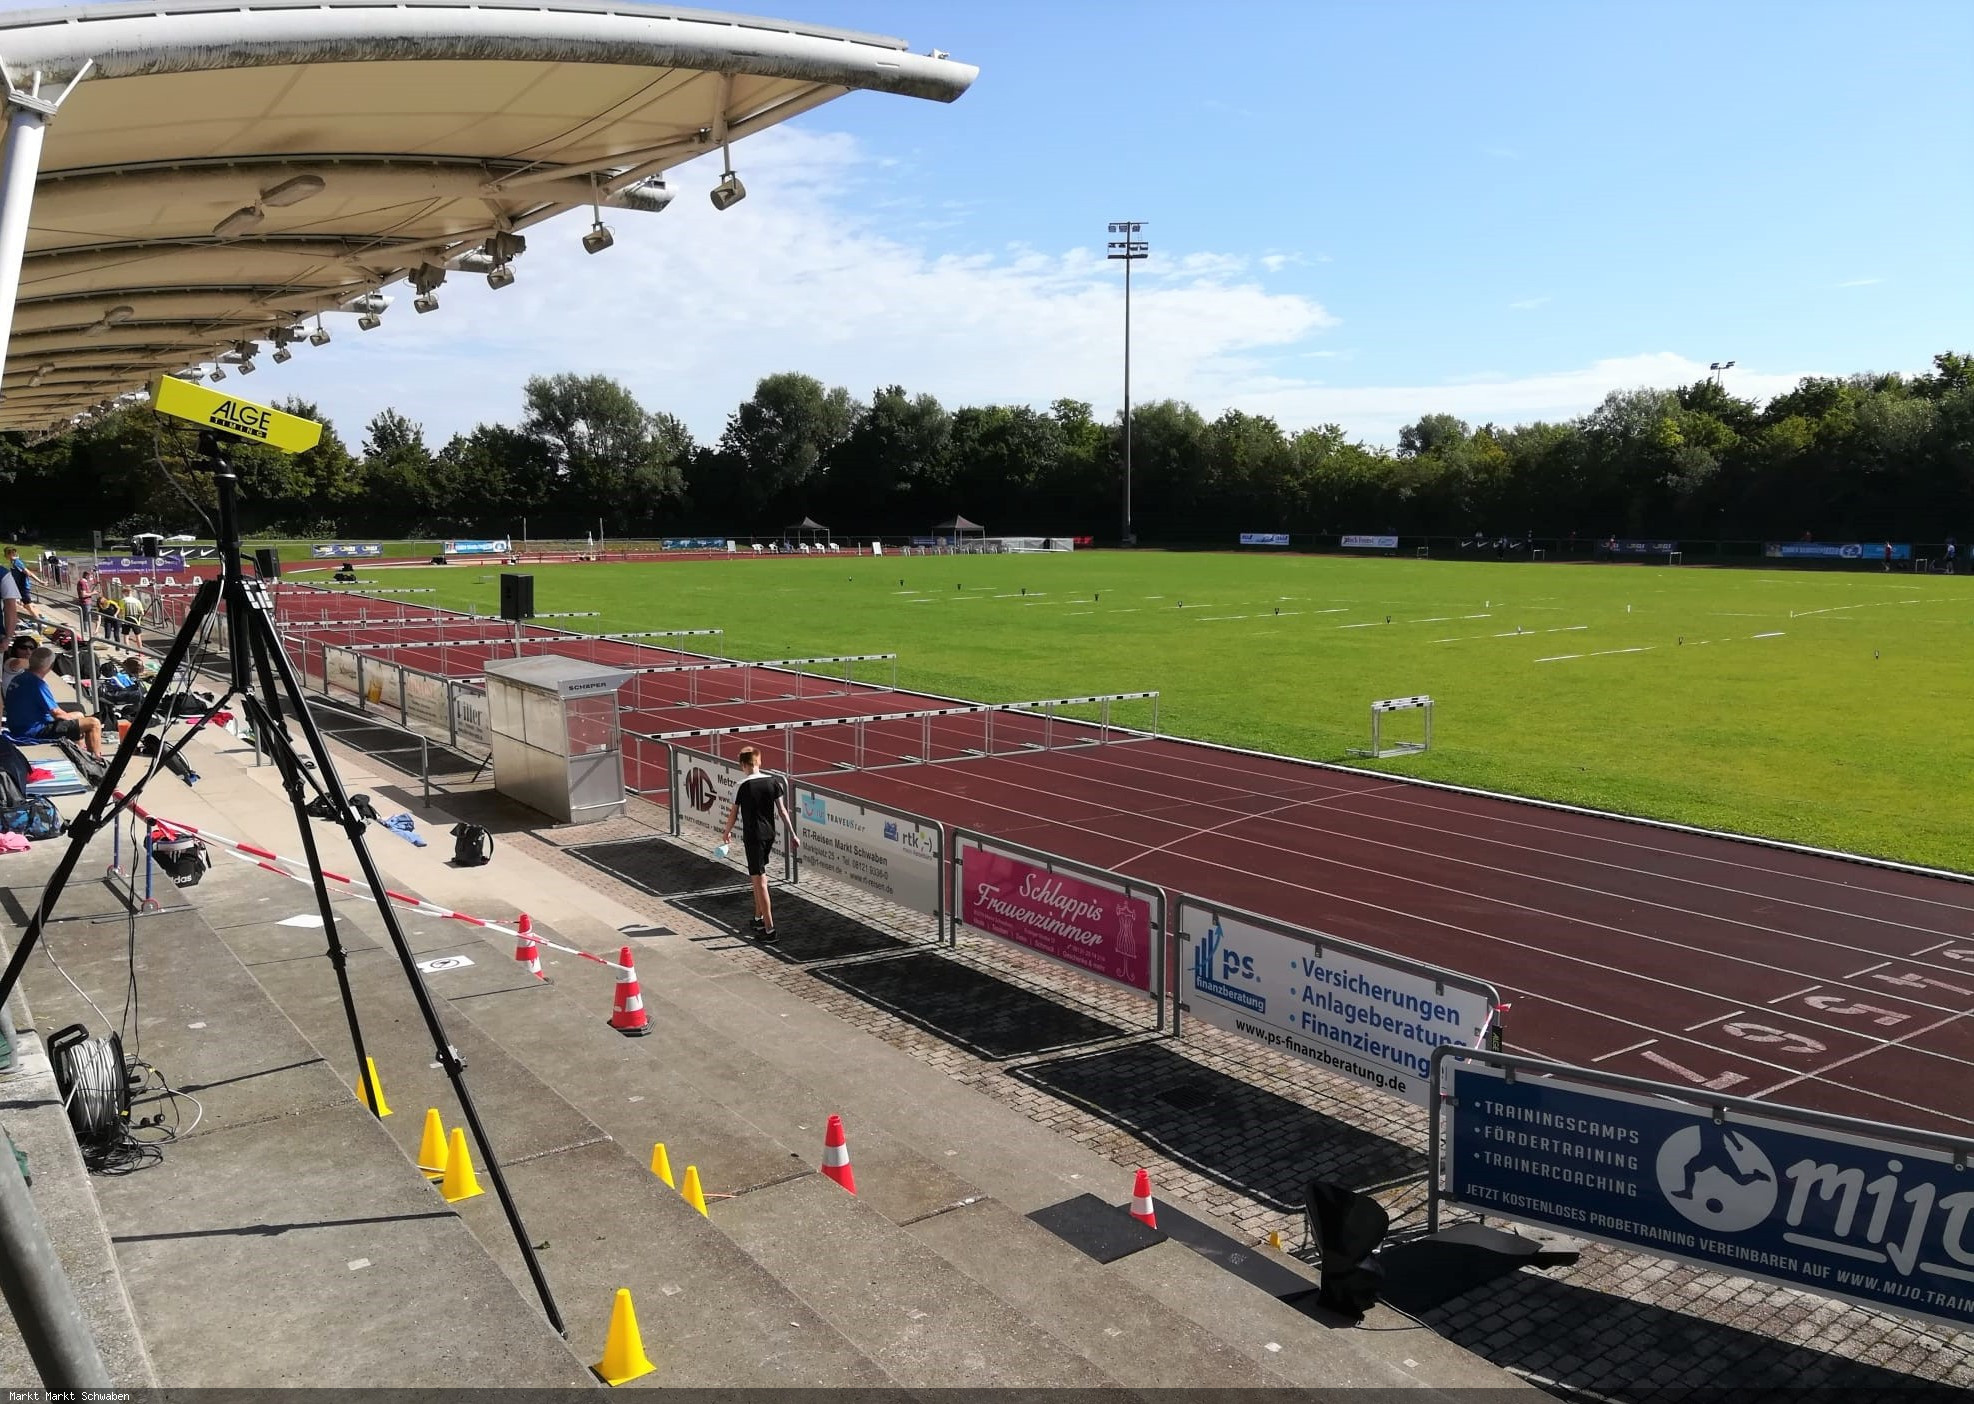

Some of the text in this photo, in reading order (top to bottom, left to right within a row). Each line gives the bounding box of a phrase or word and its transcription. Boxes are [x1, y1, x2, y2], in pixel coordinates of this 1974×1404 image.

[211, 400, 272, 431] ALGE
[212, 416, 265, 437] TIMING
[802, 827, 834, 846] RT-Reisen
[834, 838, 853, 854] Markt
[853, 845, 888, 867] Schwaben
[902, 831, 919, 849] rtk
[973, 882, 1104, 947] Frauenzimmer
[1018, 873, 1104, 922] Schlappis
[1222, 948, 1262, 983] ps.
[1196, 975, 1265, 1012] finanzberatung
[1302, 956, 1460, 1026] Versicherungen
[1235, 1019, 1407, 1093] www.ps-finanzberatung.de
[1484, 1100, 1640, 1145] TRAININGSCAMPS
[1484, 1125, 1639, 1171] FÖRDERTRAINING
[1483, 1151, 1638, 1198] TRAINERCOACHING
[1465, 1183, 1500, 1202] JETZT
[1502, 1191, 1587, 1223] KOSTENLOSES
[1589, 1211, 1695, 1249] PROBETRAINING
[1699, 1237, 1799, 1273] VEREINBAREN
[1802, 1261, 1832, 1280] AUF
